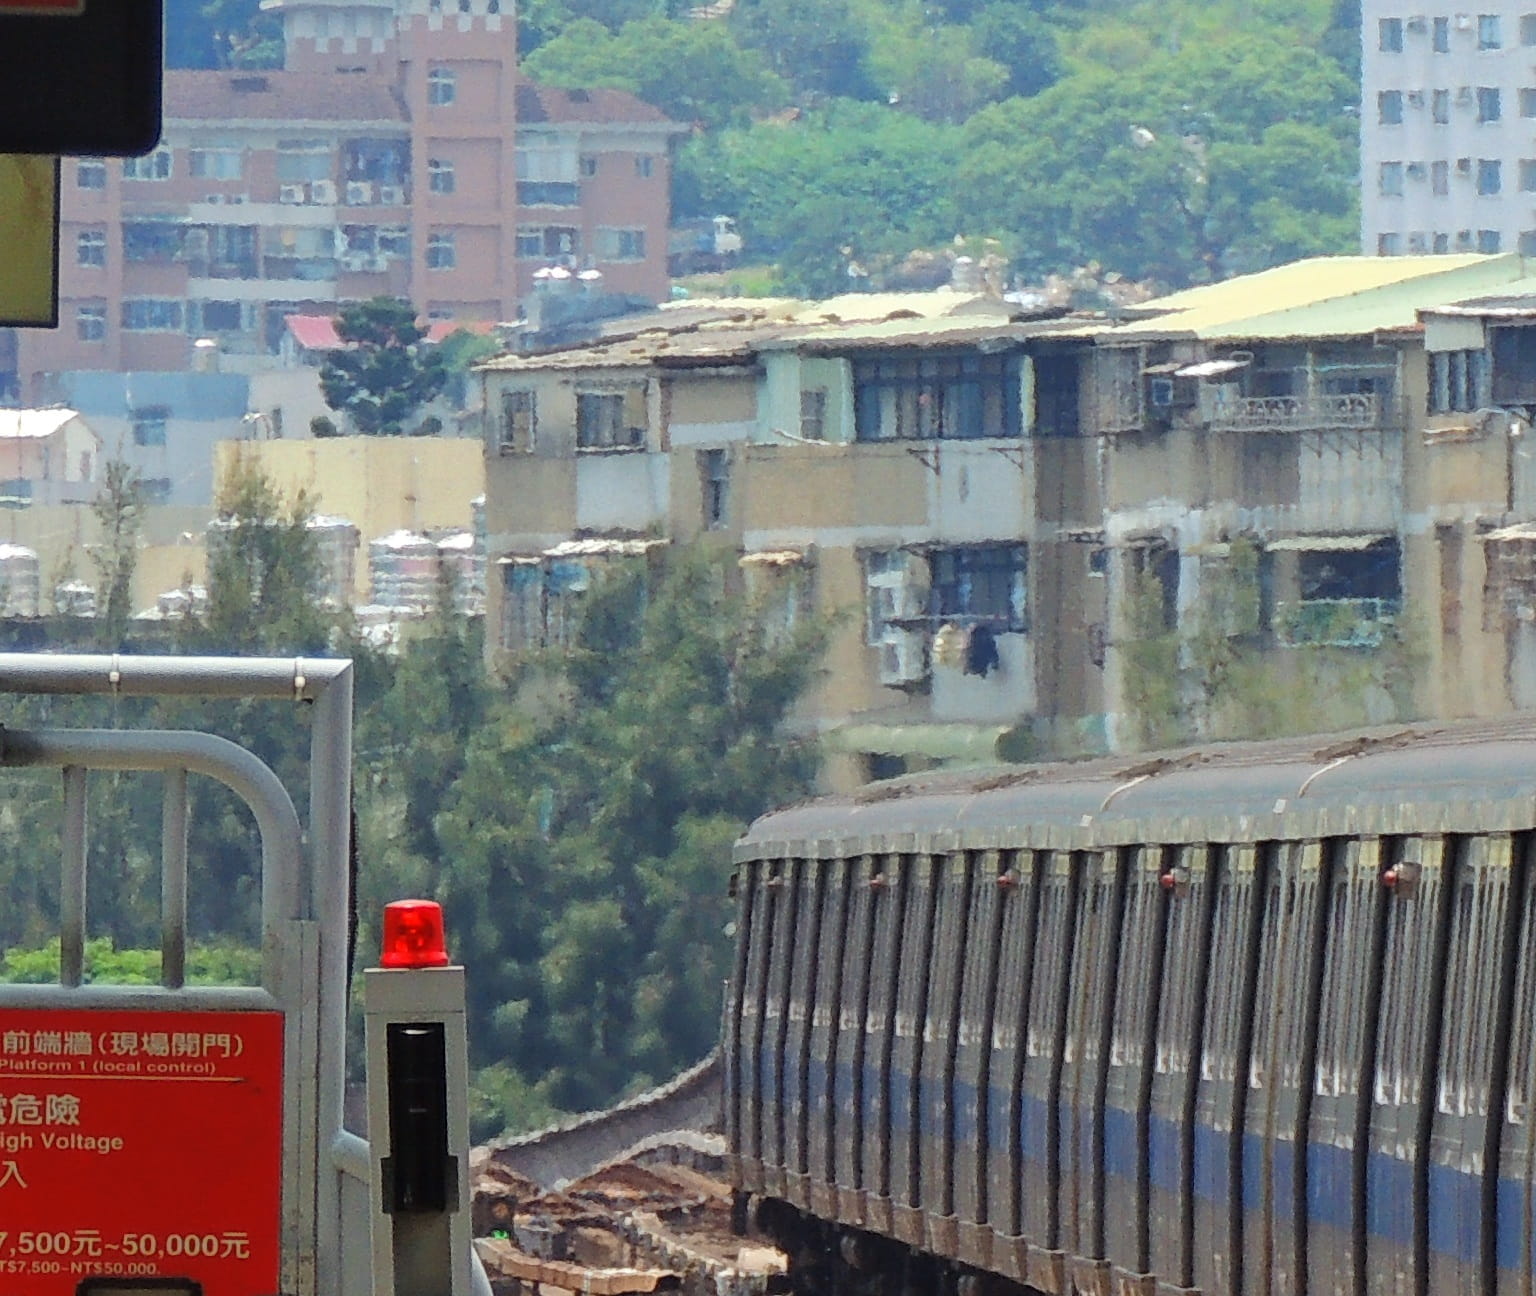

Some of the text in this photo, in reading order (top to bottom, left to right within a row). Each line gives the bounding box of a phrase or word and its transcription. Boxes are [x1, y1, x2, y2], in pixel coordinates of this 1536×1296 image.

[92, 1061, 141, 1073] (local
[147, 1061, 216, 1075] control)
[41, 1133, 124, 1154] Voltage
